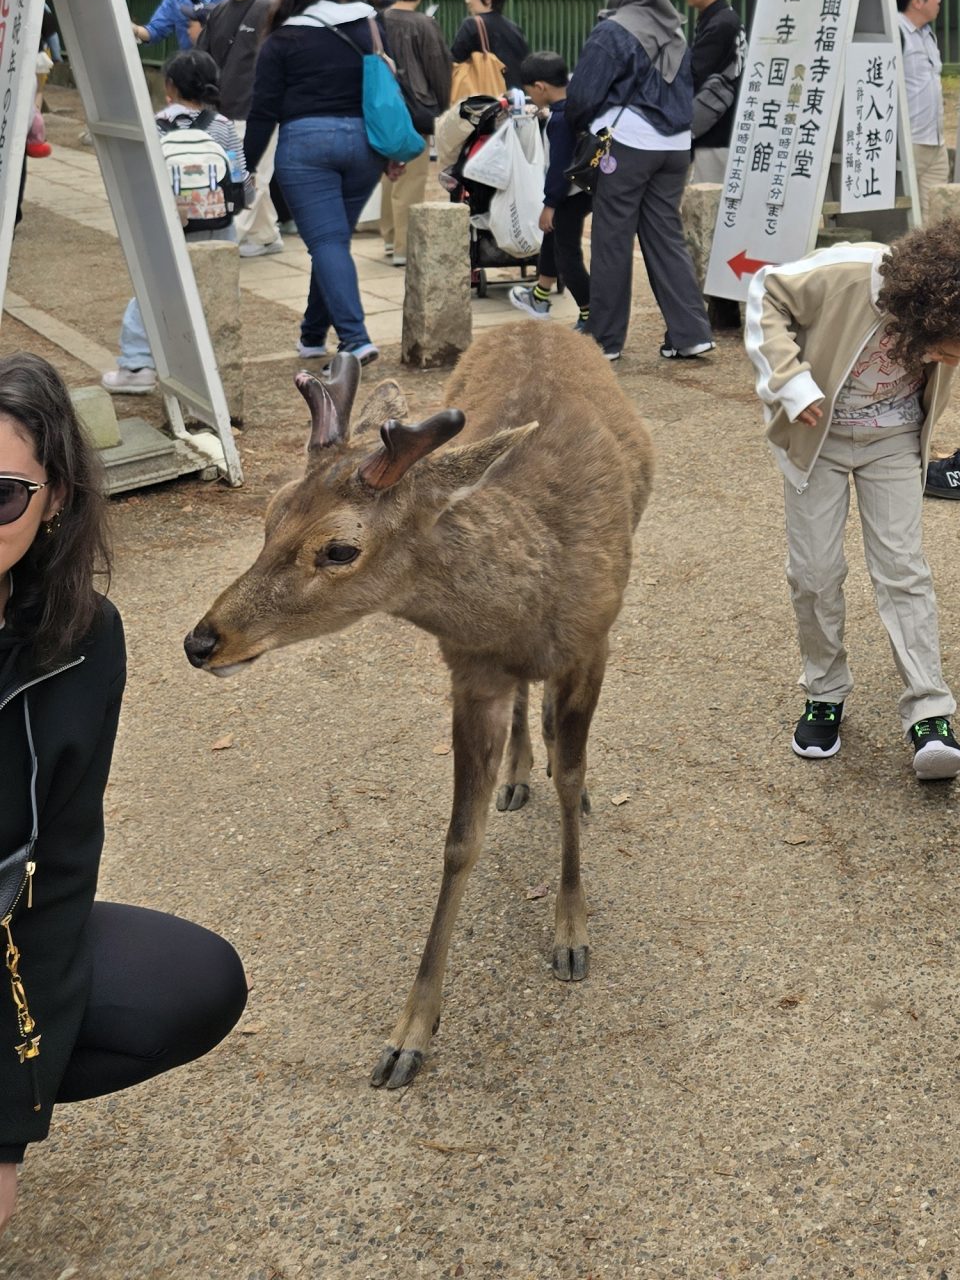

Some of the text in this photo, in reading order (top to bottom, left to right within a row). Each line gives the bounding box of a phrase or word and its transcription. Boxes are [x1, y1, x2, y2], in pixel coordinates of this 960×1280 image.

[862, 55, 885, 198] 進入禁止
[885, 55, 897, 145] バイクの
[845, 130, 855, 192] 興福寺
